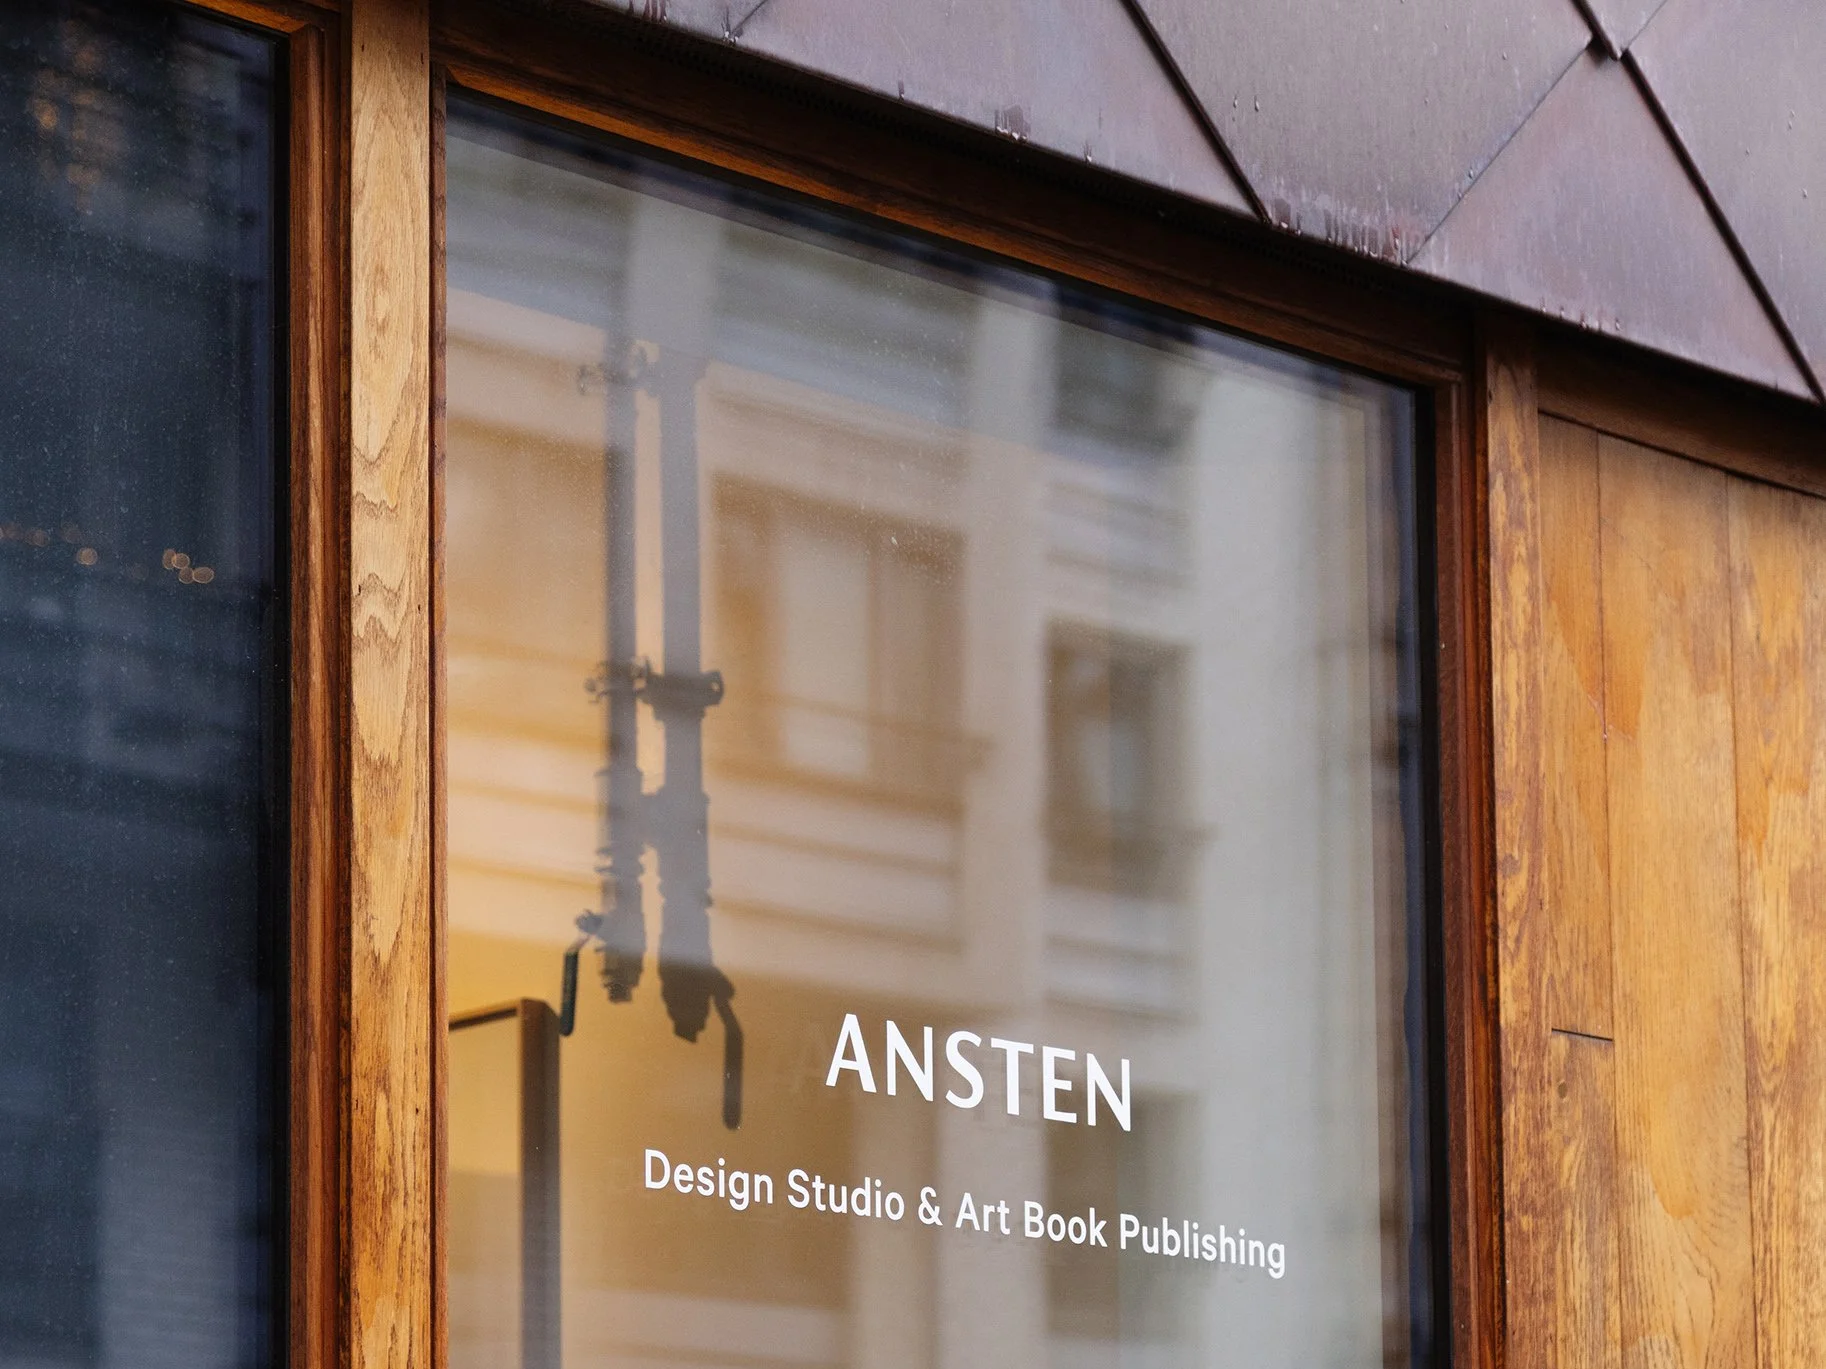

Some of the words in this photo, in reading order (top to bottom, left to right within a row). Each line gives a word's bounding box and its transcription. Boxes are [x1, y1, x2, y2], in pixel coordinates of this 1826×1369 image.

[825, 1013, 1132, 1132] ANSTEN
[643, 1148, 774, 1210] Design
[787, 1169, 905, 1221] Studio
[917, 1186, 943, 1226] &
[955, 1192, 1010, 1235] Art
[1024, 1201, 1108, 1248] Book
[1119, 1214, 1286, 1278] Publishing
